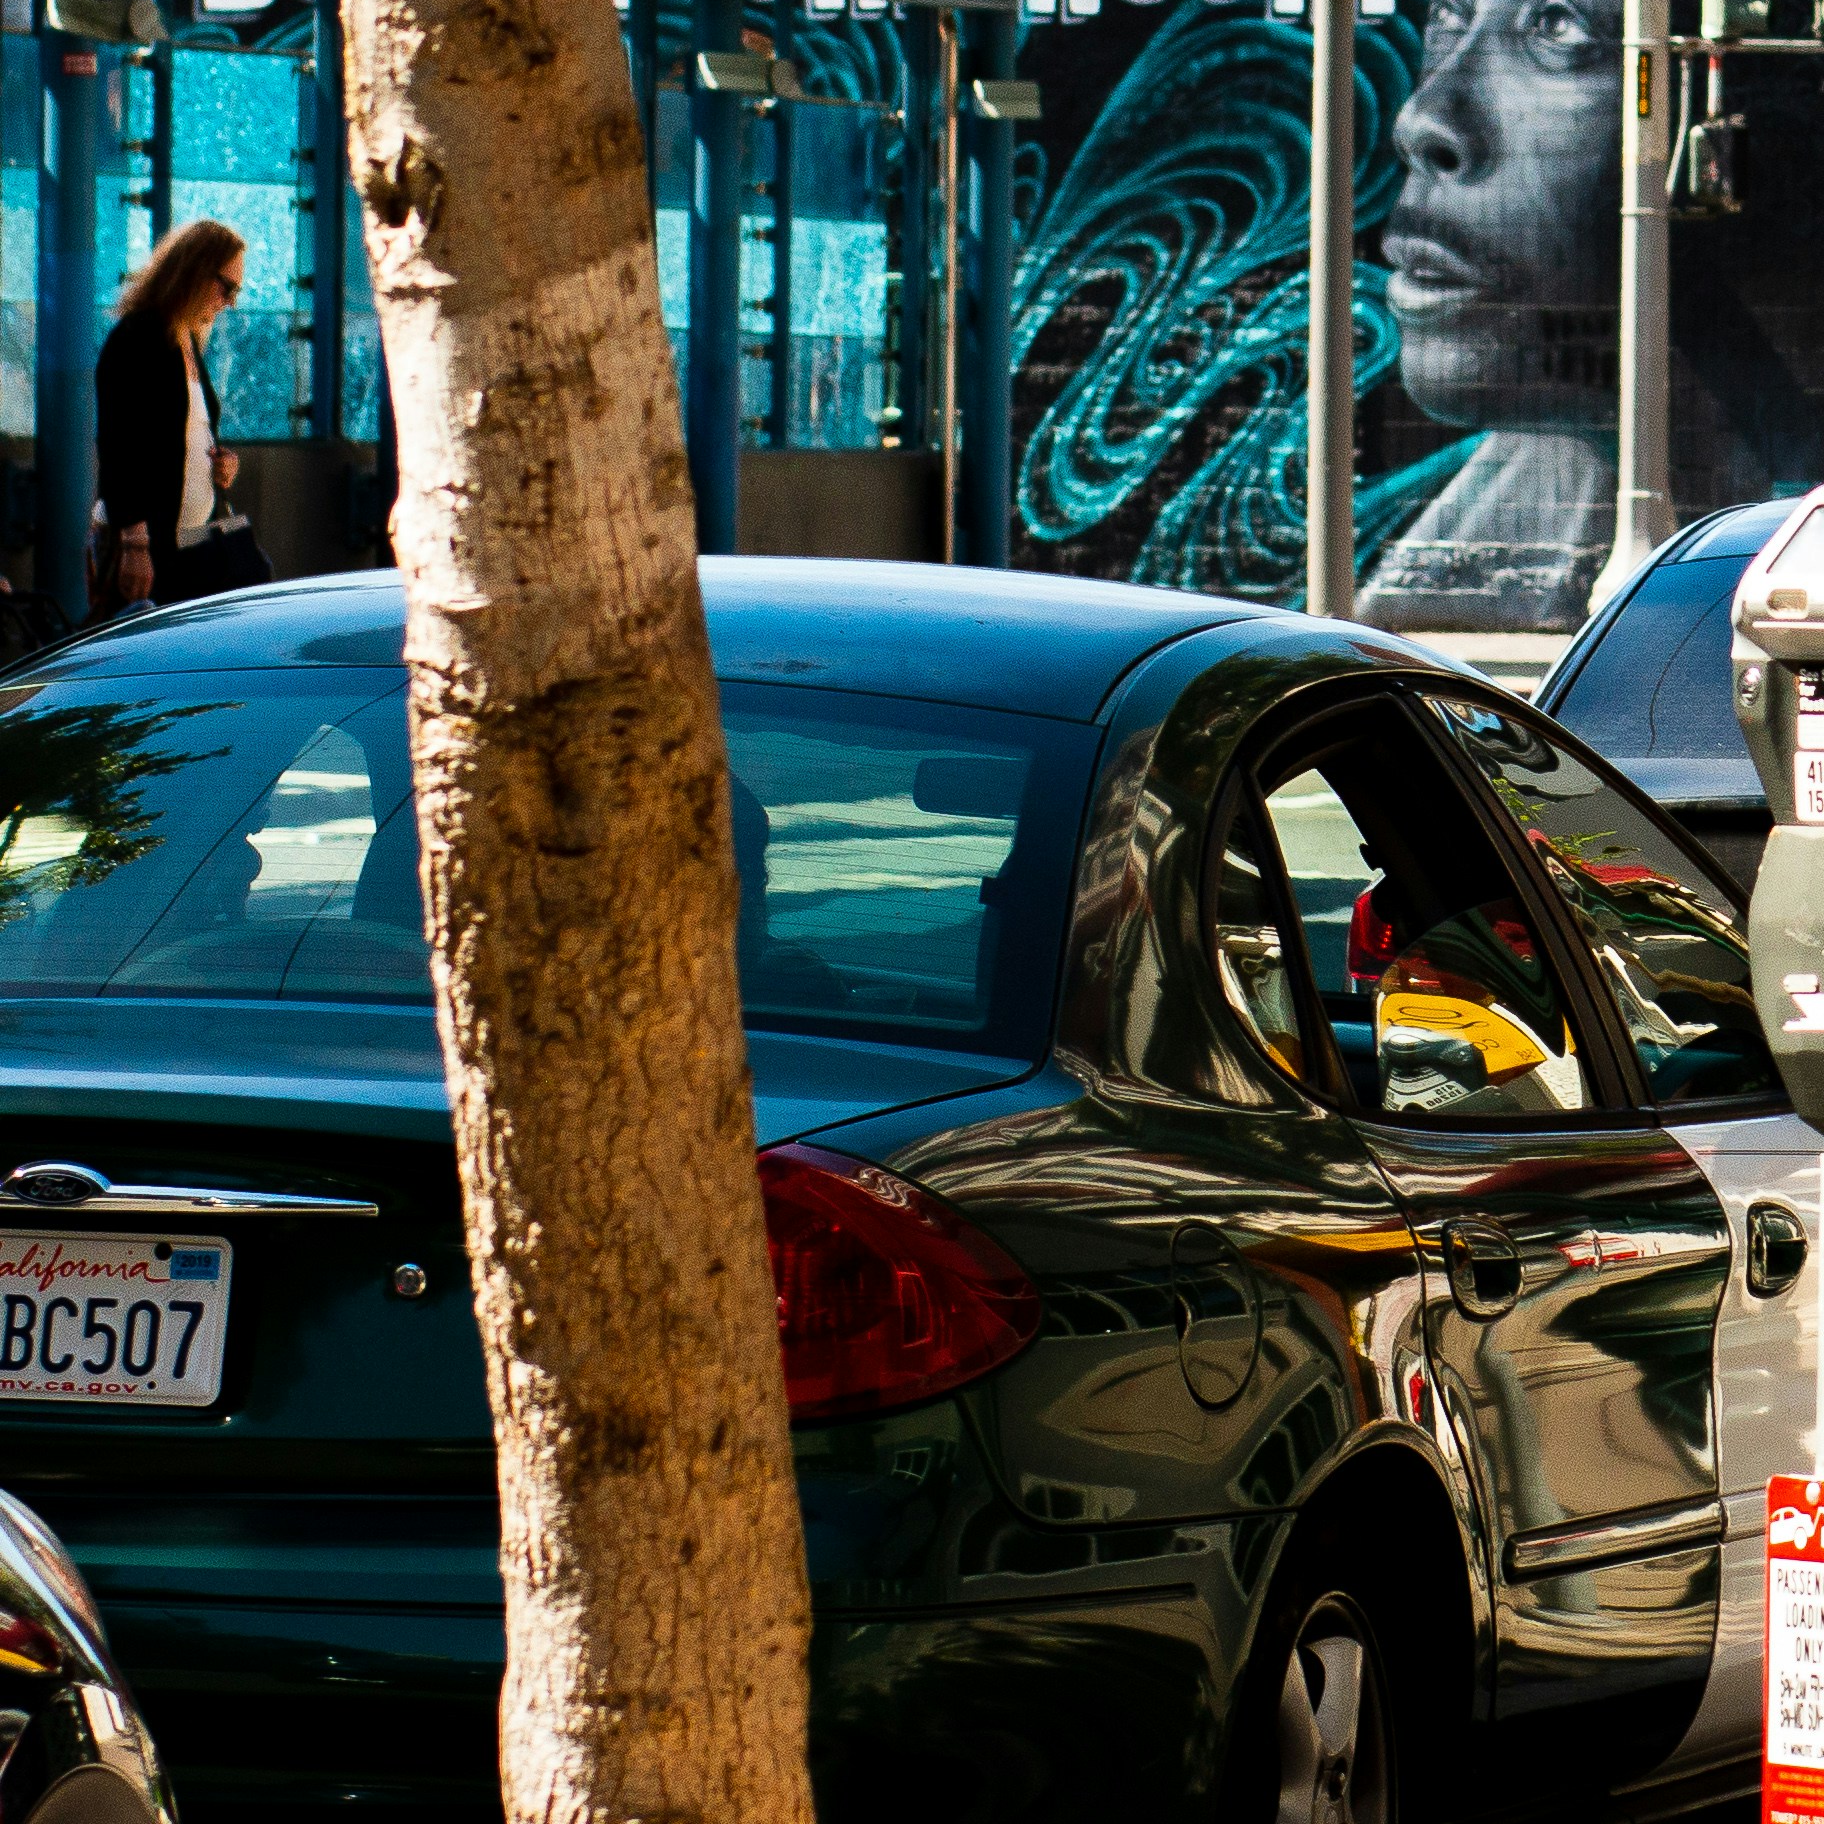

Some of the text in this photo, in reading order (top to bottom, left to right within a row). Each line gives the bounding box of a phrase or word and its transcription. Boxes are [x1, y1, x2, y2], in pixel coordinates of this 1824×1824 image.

[30, 1175, 76, 1198] Ford
[0, 1240, 172, 1293] alifornia
[180, 1254, 212, 1268] 2019
[0, 1293, 205, 1380] BC507
[1795, 1636, 1824, 1664] ONLY
